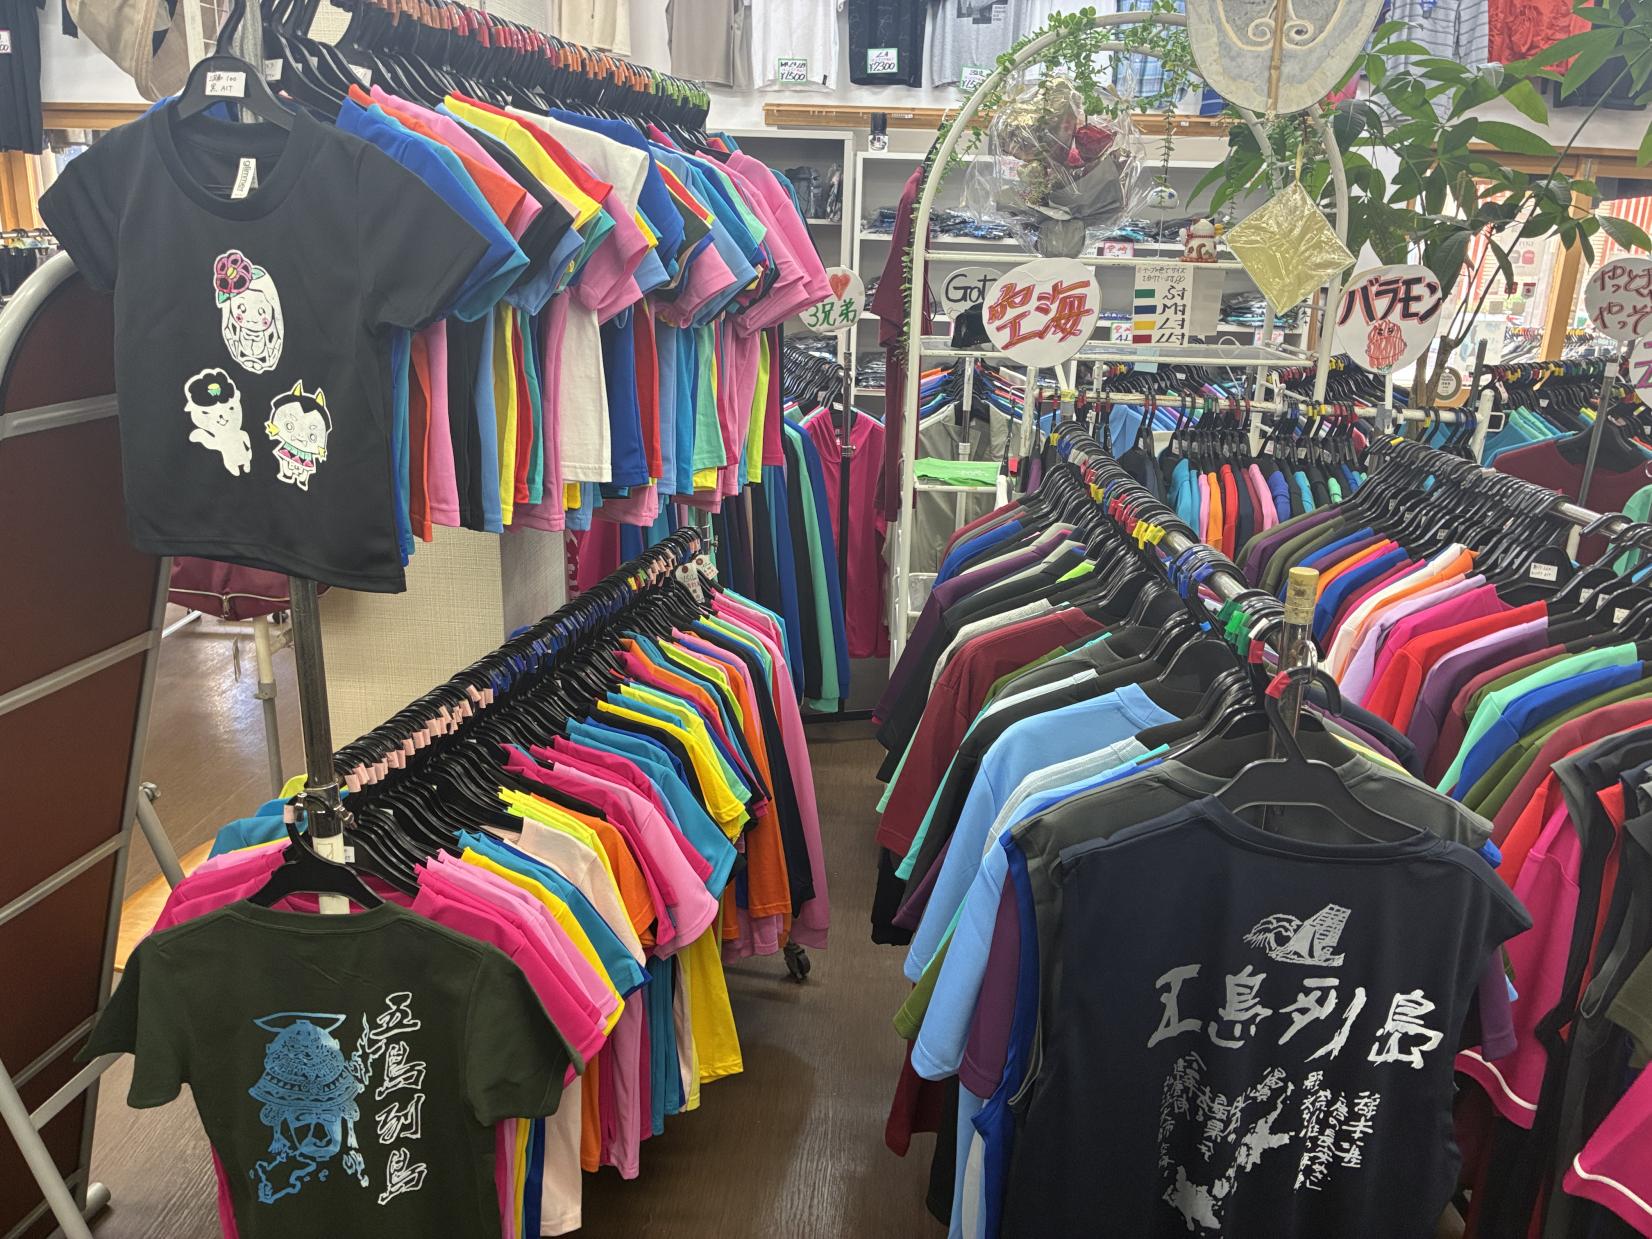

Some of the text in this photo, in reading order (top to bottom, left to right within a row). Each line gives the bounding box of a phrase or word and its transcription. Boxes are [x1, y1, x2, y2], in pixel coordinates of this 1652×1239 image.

[780, 71, 806, 81] ¥1500
[869, 61, 896, 72] ¥2300
[1337, 276, 1442, 326] バラモン
[807, 297, 857, 328] 3兄弟
